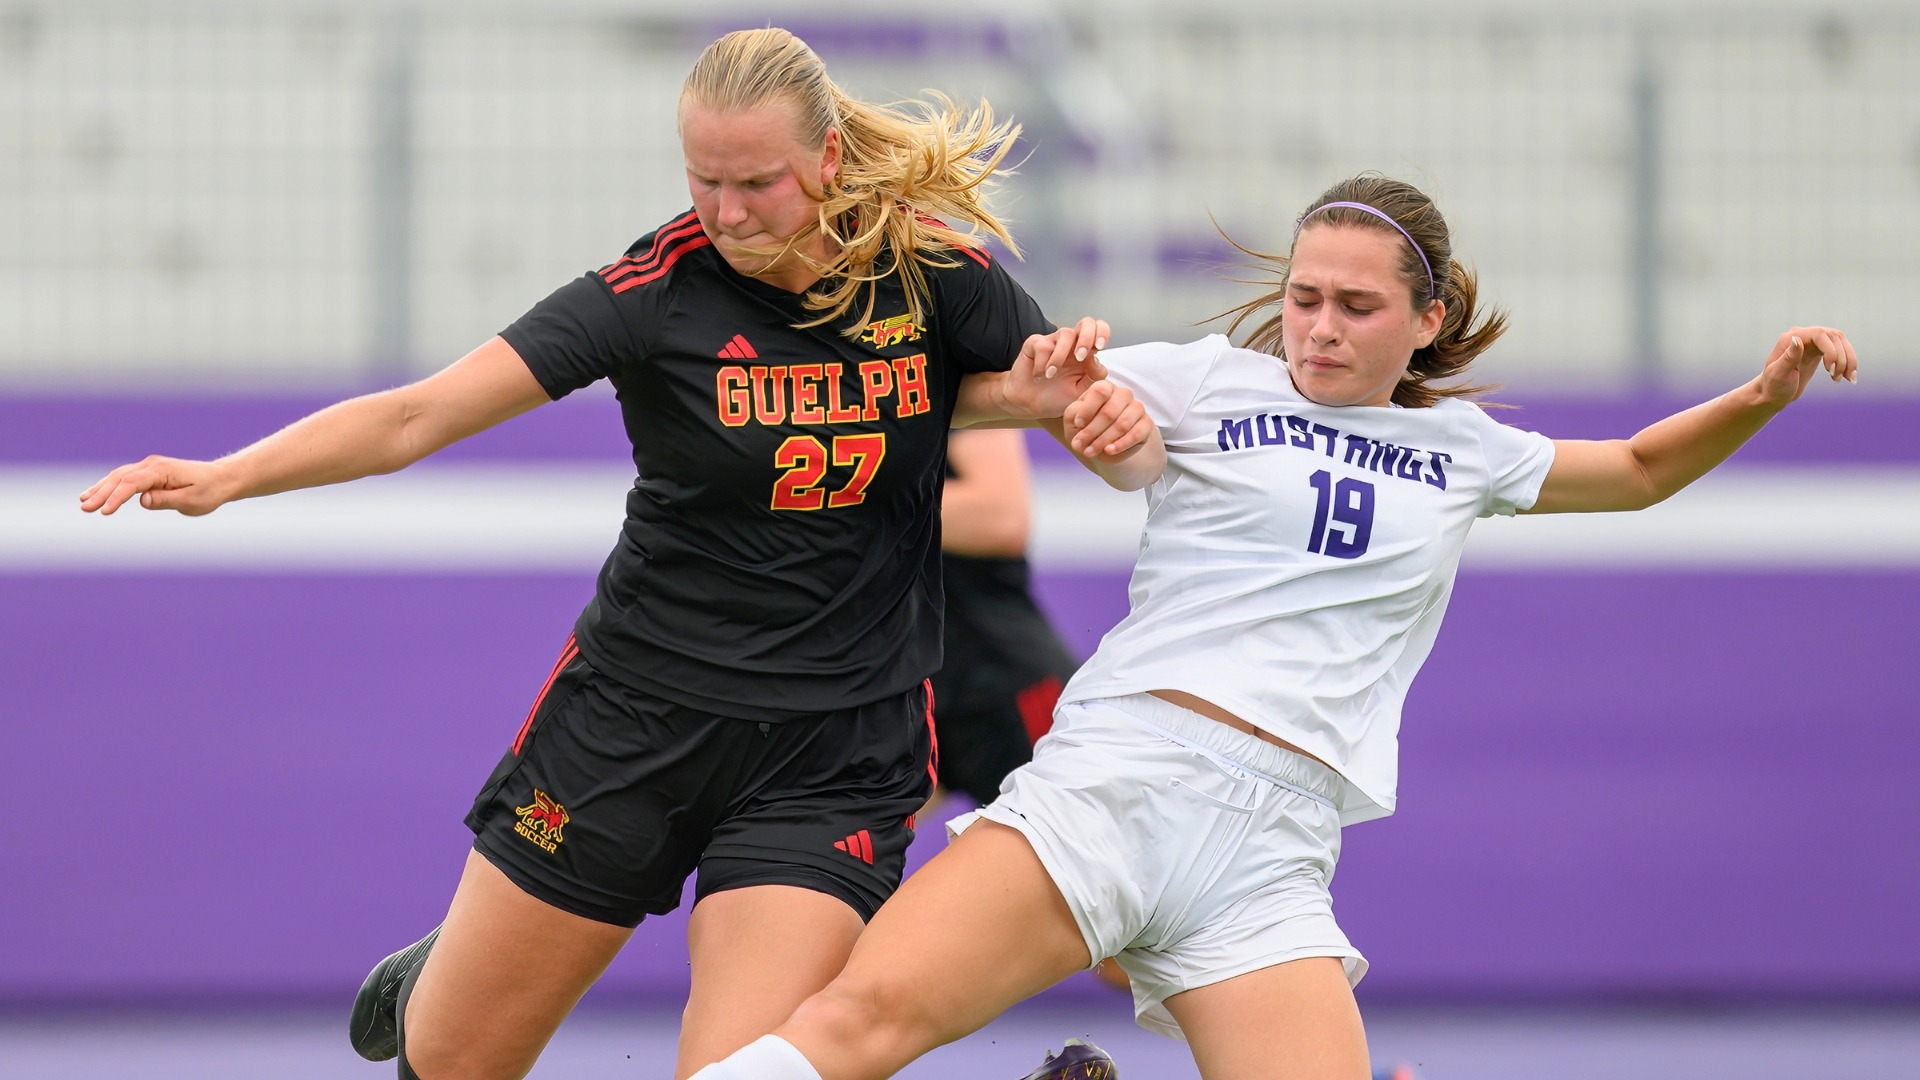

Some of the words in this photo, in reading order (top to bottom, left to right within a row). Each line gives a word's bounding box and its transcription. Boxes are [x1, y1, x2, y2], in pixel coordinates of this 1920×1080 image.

[716, 353, 931, 428] GUELPH
[770, 432, 886, 511] 27
[1217, 413, 1452, 492] MUSTANGS
[1307, 469, 1375, 559] 19
[514, 821, 557, 854] SOCCER
